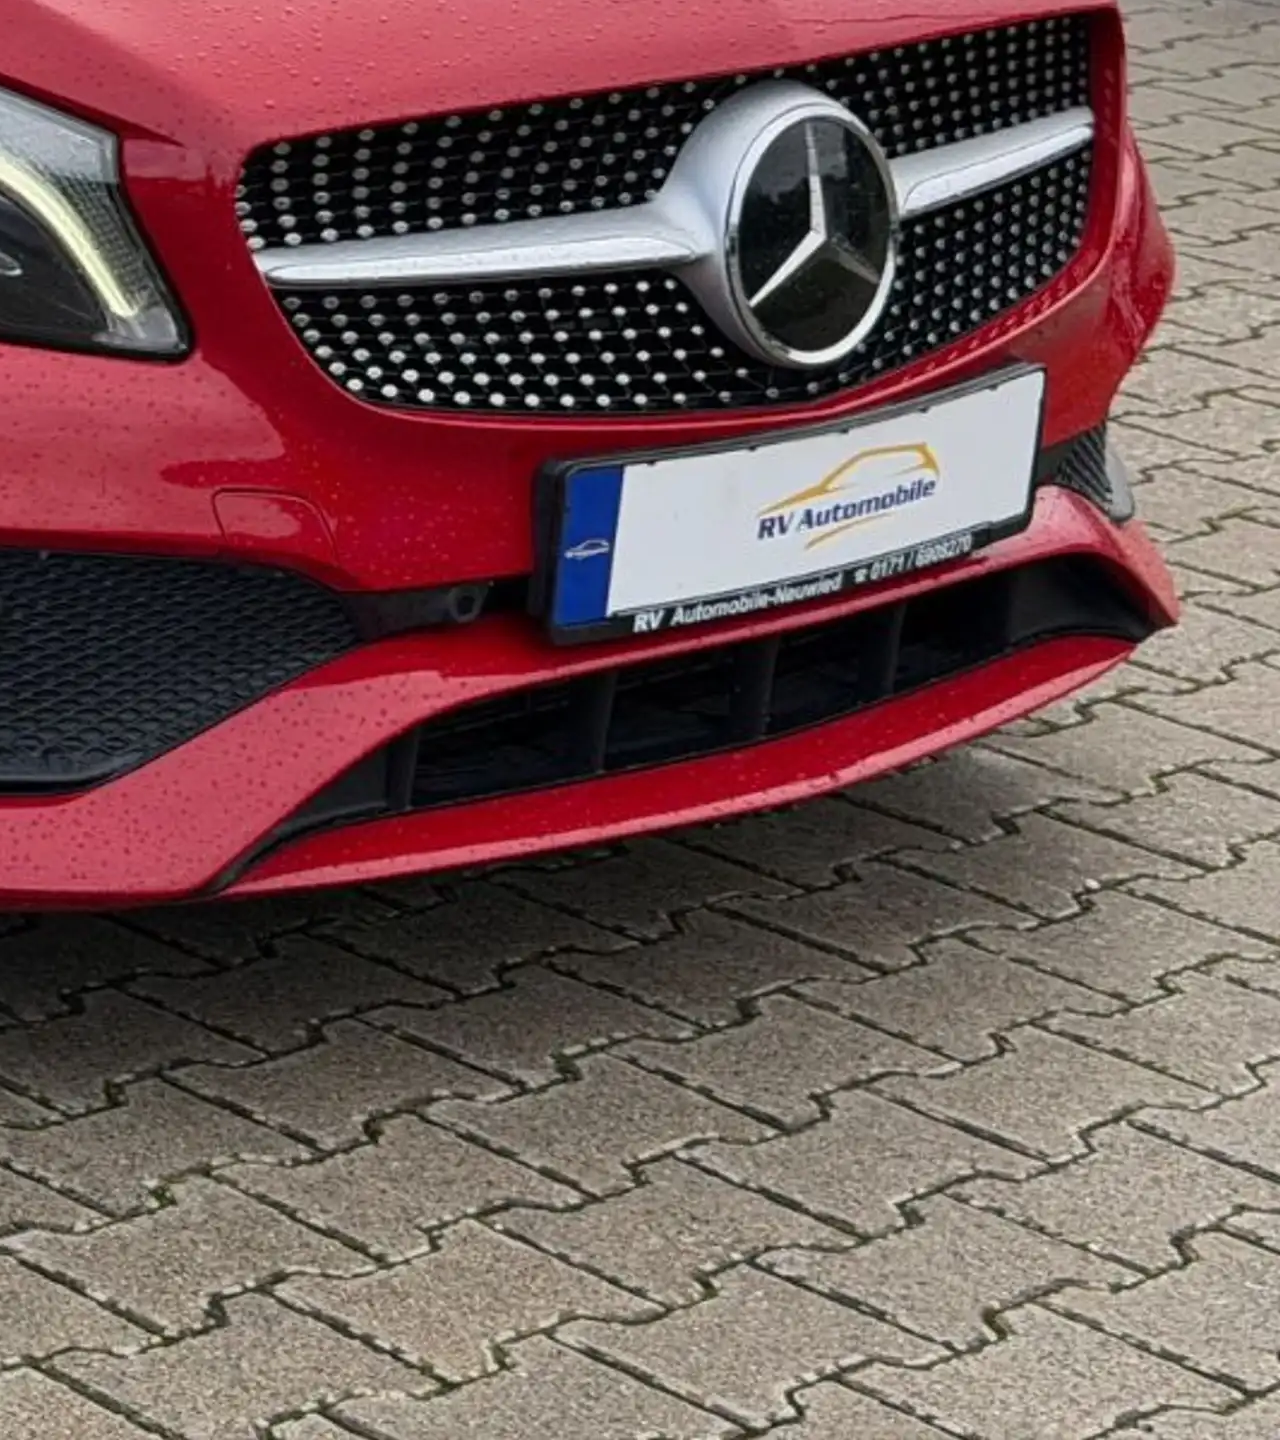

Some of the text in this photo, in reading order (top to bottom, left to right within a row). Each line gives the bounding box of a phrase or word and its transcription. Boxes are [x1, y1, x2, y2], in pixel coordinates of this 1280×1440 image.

[757, 477, 937, 541] RV Automobile
[632, 610, 666, 633] RV
[669, 570, 845, 627] Automobile-Neuwied
